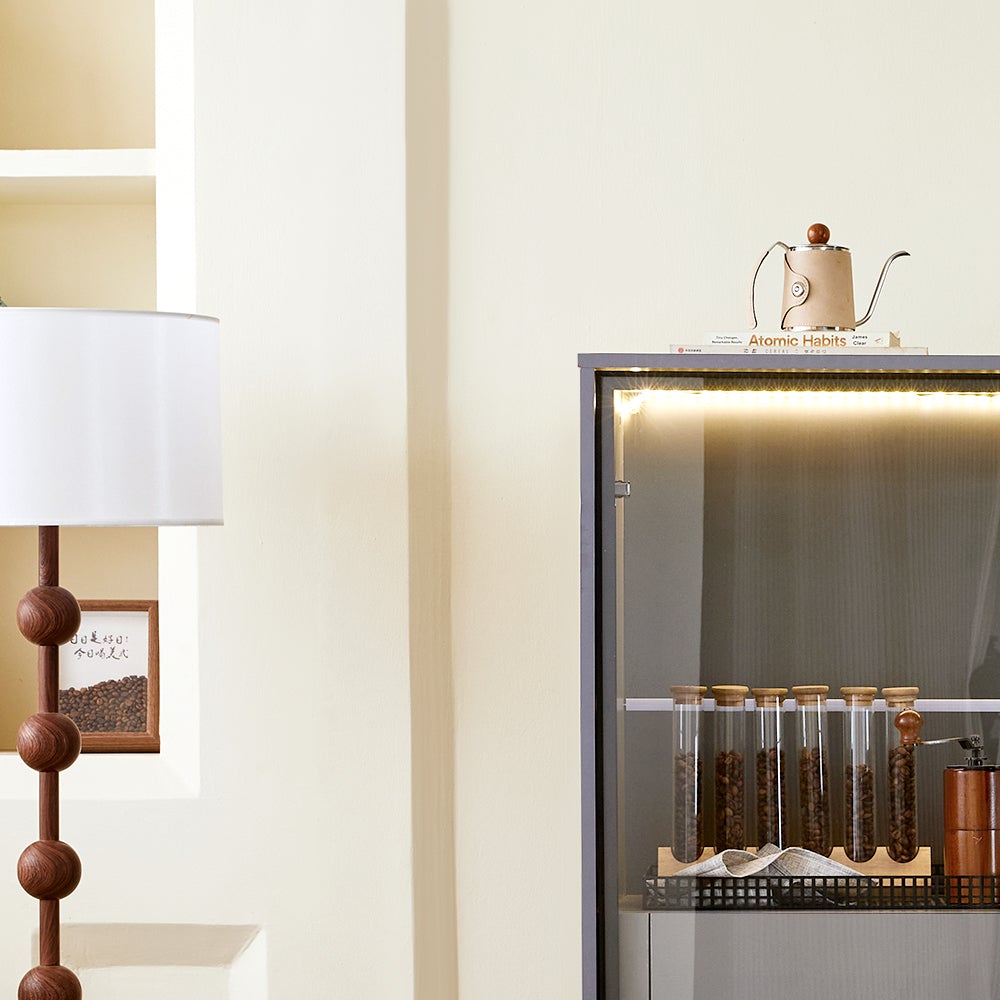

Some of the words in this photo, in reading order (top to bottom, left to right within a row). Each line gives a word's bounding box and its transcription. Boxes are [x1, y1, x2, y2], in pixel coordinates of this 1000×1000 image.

[748, 334, 799, 347] Atomic
[803, 334, 847, 347] Habits
[71, 630, 128, 645] 日日是好日
